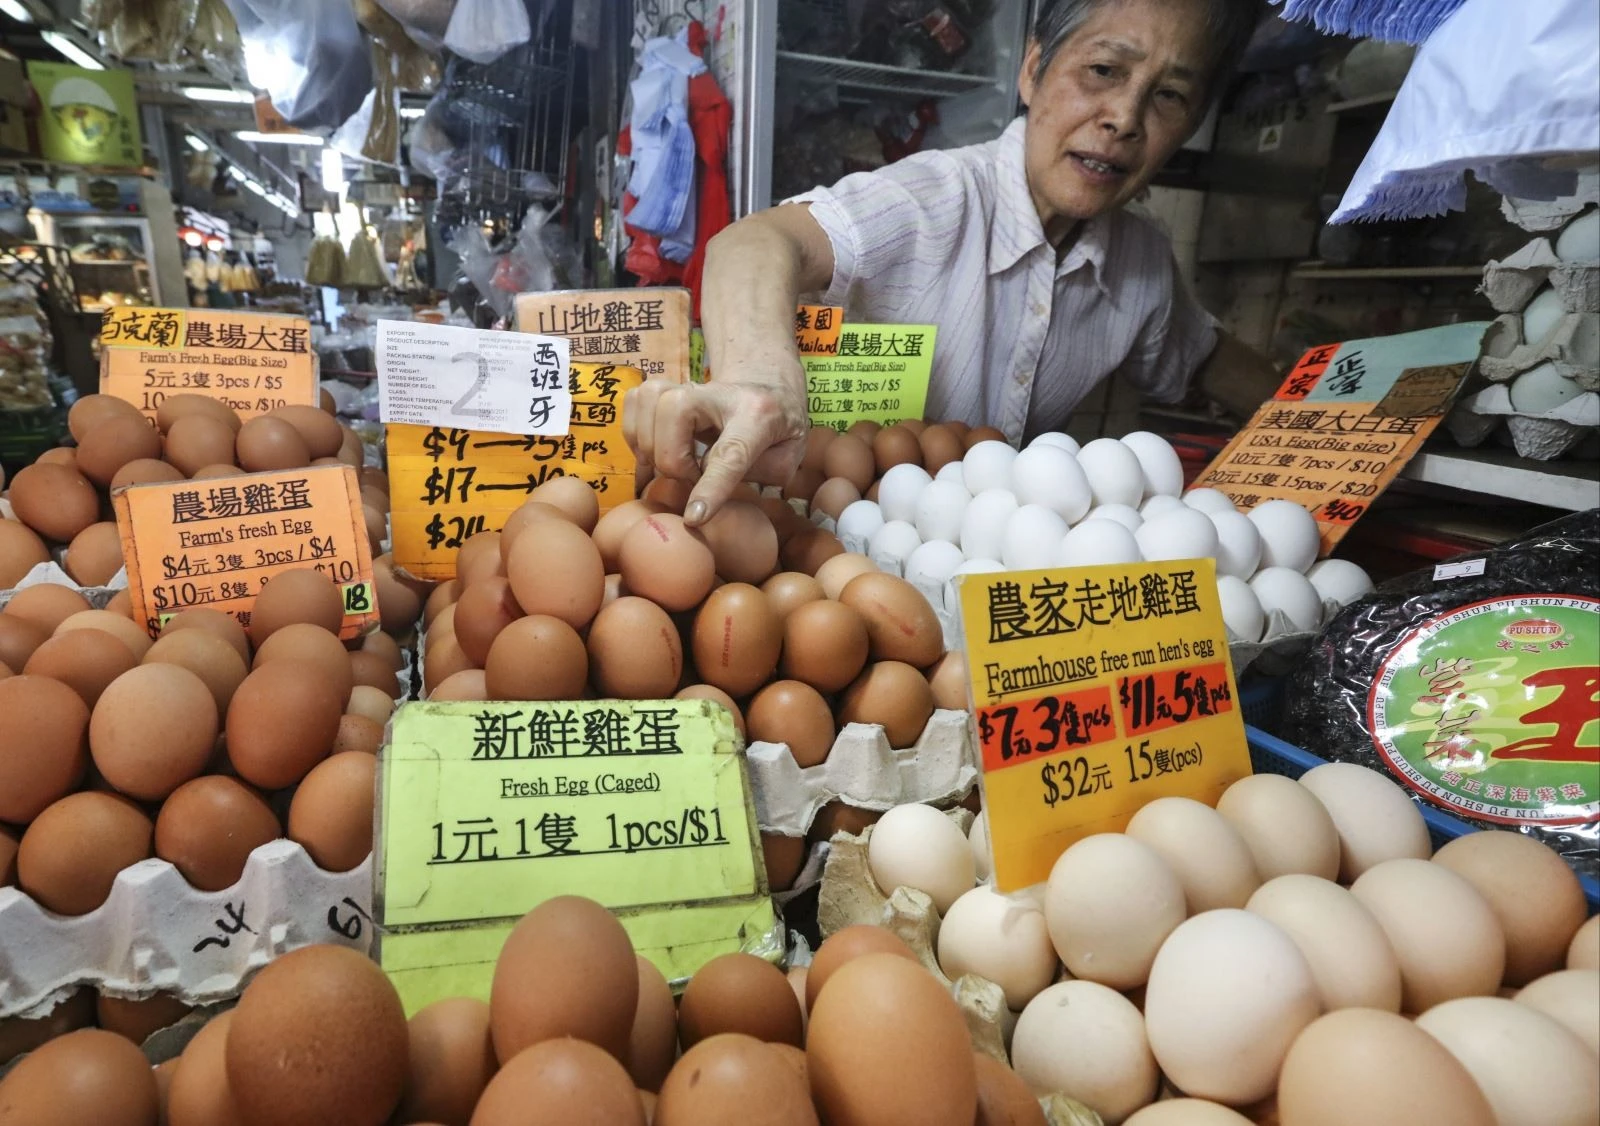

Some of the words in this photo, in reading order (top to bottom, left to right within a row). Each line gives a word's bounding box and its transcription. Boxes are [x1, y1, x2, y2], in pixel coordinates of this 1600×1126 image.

[539, 300, 664, 334] 山地雞蛋
[184, 321, 308, 353] 農場大蛋
[840, 332, 924, 356] 農場大蛋
[140, 351, 177, 364] Farm's
[179, 352, 210, 365] Fresh
[213, 353, 257, 368] Egg(Big
[261, 355, 288, 369] Size)
[640, 358, 665, 374] Egg
[806, 361, 832, 372] Farm's
[834, 361, 854, 372] Fresh
[887, 361, 906, 373] Size)
[144, 369, 176, 388] 5元
[182, 371, 210, 388] 3隻
[216, 373, 250, 389] 3pcs
[265, 375, 283, 390] $5
[528, 343, 562, 428] 西班牙
[808, 377, 830, 393] 5元
[856, 379, 879, 392] 3pcs
[887, 378, 901, 391] $5
[588, 404, 616, 423] Egg
[807, 397, 833, 413] 10元
[857, 399, 878, 412] 7pcs
[582, 439, 609, 463] pcs
[1249, 434, 1283, 448] USA
[1289, 435, 1349, 453] Egg(Big
[1352, 439, 1397, 455] size)
[1229, 452, 1265, 465] 10元
[1299, 455, 1336, 470] 7pcs
[1348, 459, 1388, 475] $10
[420, 466, 477, 505] $17
[1206, 470, 1241, 483] 20元
[1282, 475, 1328, 491] 15pcs
[1340, 482, 1380, 498] $20
[172, 479, 313, 524] 農場雞蛋
[178, 527, 235, 549] Farm's
[238, 521, 277, 540] fresh
[282, 519, 313, 535] Egg
[161, 554, 211, 579] $4元
[216, 553, 243, 573] 3隻
[255, 549, 293, 567] 3pcs
[309, 536, 336, 559] $4
[152, 582, 216, 610] $10元
[220, 582, 249, 600] 8隻
[345, 583, 369, 610] 18
[988, 570, 1201, 643] 農家走地雞蛋
[1453, 604, 1492, 622] SHUN
[1520, 598, 1564, 606] SHUN
[1570, 600, 1592, 609] PU
[1509, 627, 1522, 635] PU
[1526, 626, 1558, 634] SHUN
[984, 654, 1099, 697] Farmhouse
[1100, 650, 1129, 673] free
[1132, 647, 1157, 667] run
[1158, 638, 1190, 661] hen's
[1193, 638, 1215, 659] egg
[1375, 696, 1385, 709] PU
[472, 708, 683, 759] 新鮮雞蛋
[1393, 754, 1422, 782] SHUN
[500, 777, 549, 798] Fresh
[554, 776, 589, 797] Egg
[594, 773, 662, 796] (Caged)
[1041, 757, 1113, 808] $32元
[1421, 780, 1440, 794] PU
[1441, 792, 1484, 811] SHUN
[1490, 807, 1509, 817] PU
[431, 817, 499, 862] 1元
[515, 812, 579, 857] 1隻
[605, 806, 728, 854] 1pcs/$1
